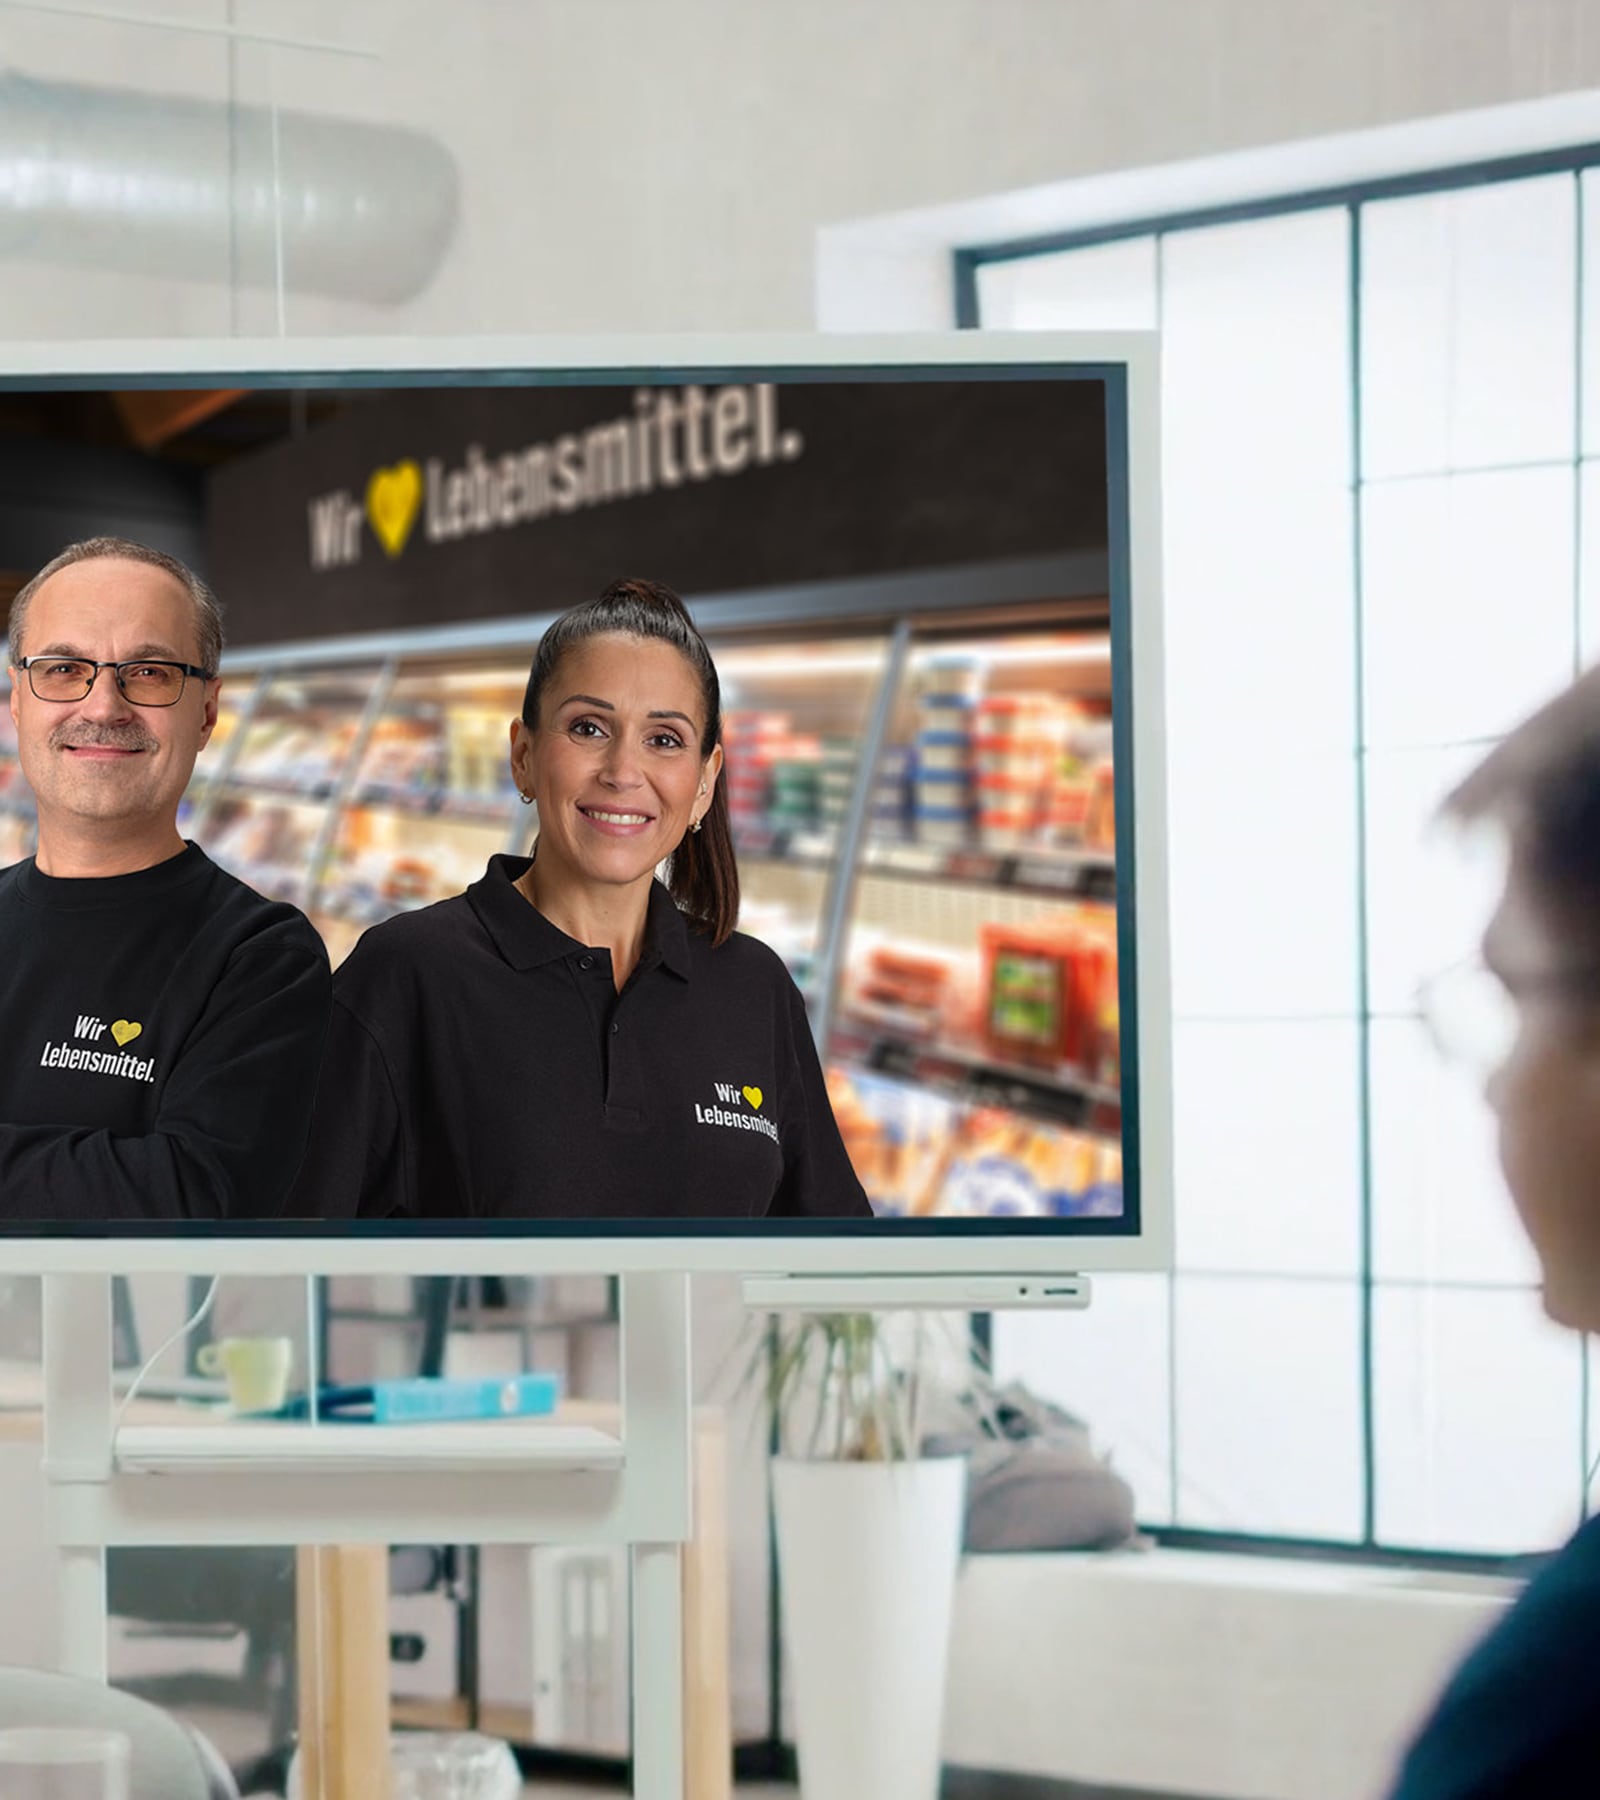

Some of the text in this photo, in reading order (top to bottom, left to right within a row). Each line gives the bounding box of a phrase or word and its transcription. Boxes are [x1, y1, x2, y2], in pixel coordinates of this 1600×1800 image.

[309, 383, 803, 571] Wir Lebensmittel.
[73, 1014, 107, 1041] Wir
[40, 1041, 156, 1083] Lebensmittel.
[714, 1082, 741, 1105] Wir
